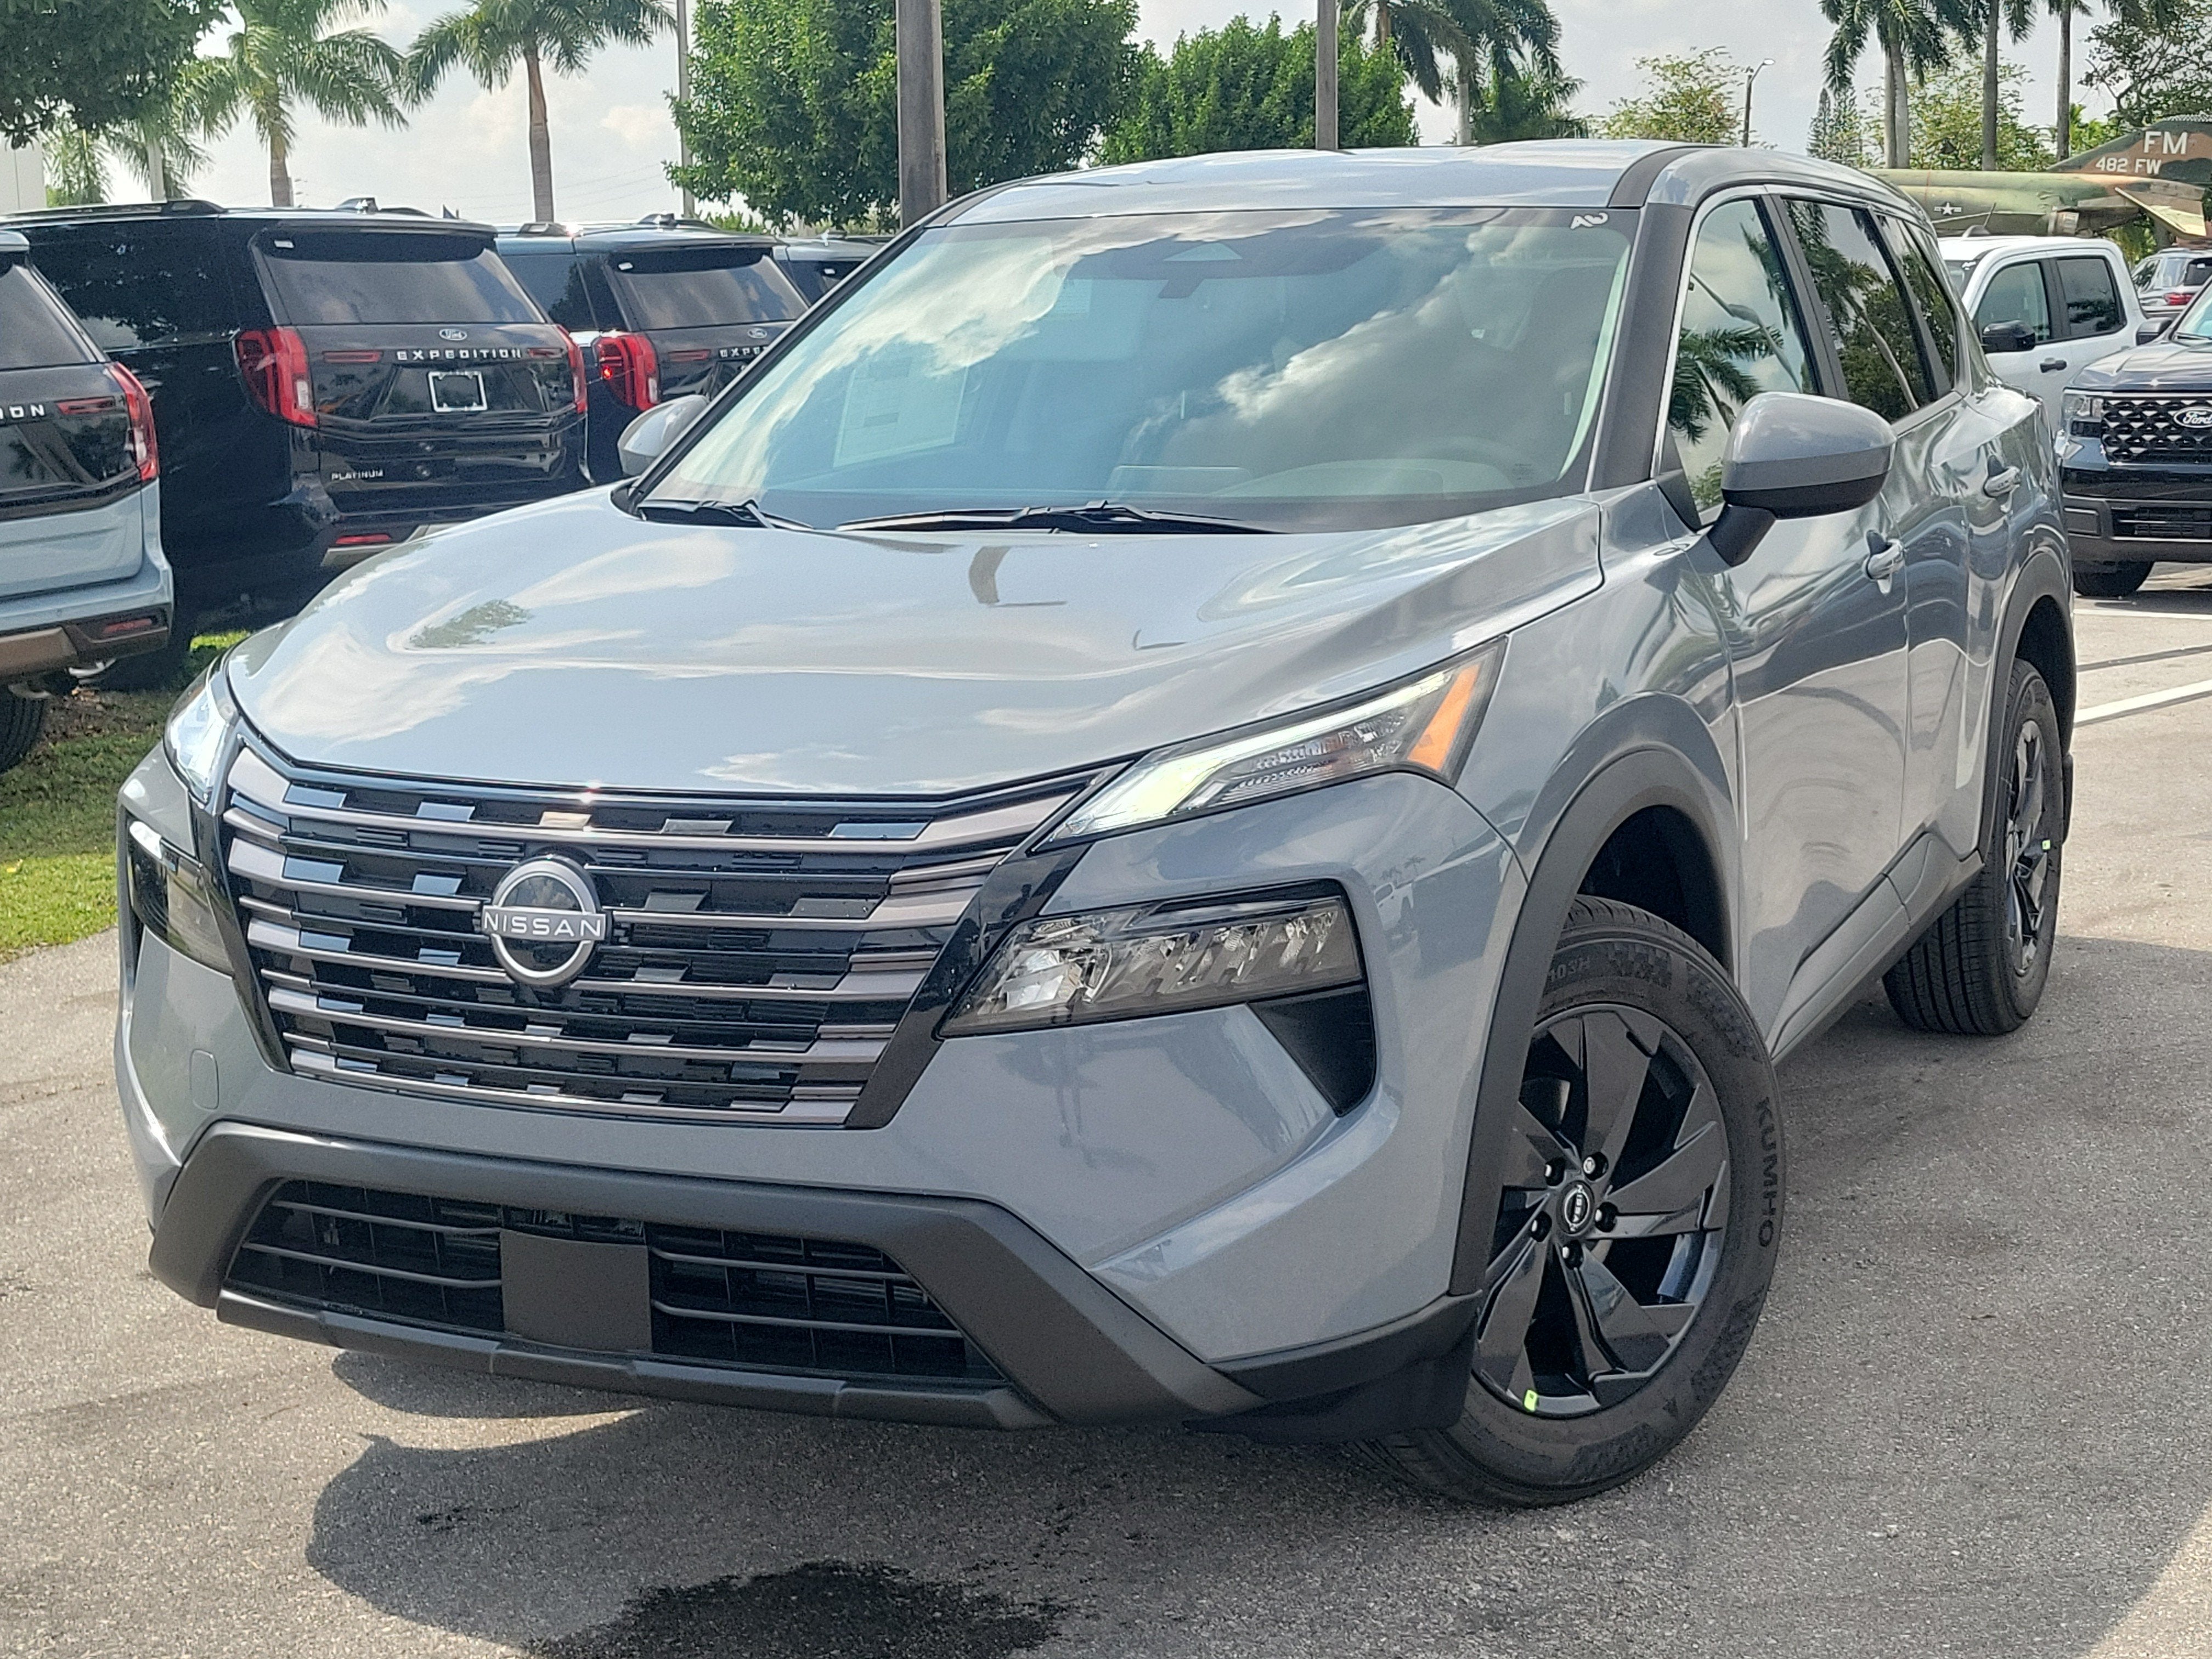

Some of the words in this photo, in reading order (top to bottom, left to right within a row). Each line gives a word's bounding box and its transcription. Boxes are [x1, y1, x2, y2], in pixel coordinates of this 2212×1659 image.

[2144, 131, 2188, 154] FM
[2095, 156, 2128, 173] 482
[2135, 159, 2162, 174] FW
[397, 348, 522, 360] EXPEDITION
[2183, 411, 2212, 424] Ford
[331, 469, 383, 481] PLATINUM
[484, 911, 601, 937] NISSAN
[1756, 1097, 1778, 1247] KUMHO
